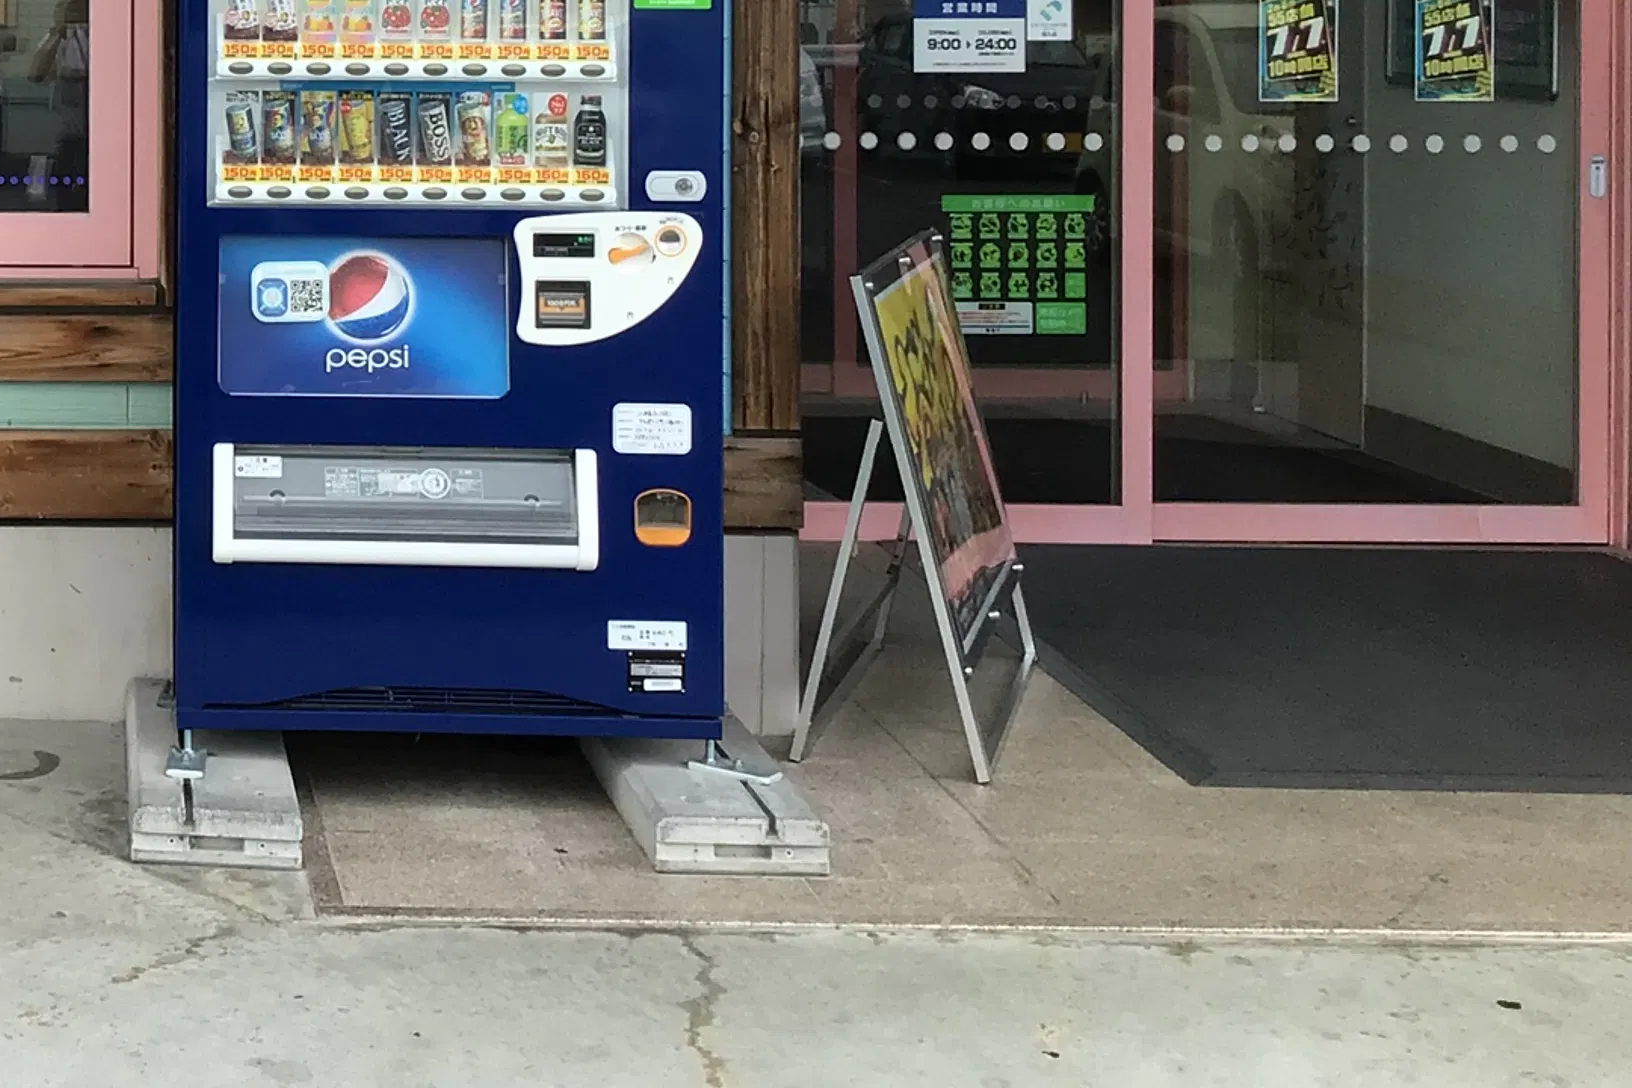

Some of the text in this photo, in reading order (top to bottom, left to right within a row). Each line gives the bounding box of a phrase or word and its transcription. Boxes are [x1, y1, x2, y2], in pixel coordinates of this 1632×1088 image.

[927, 38, 1017, 51] 9:00 24:00
[387, 104, 412, 161] BLACK
[429, 111, 450, 162] BOSS
[325, 344, 410, 373] pepsi
